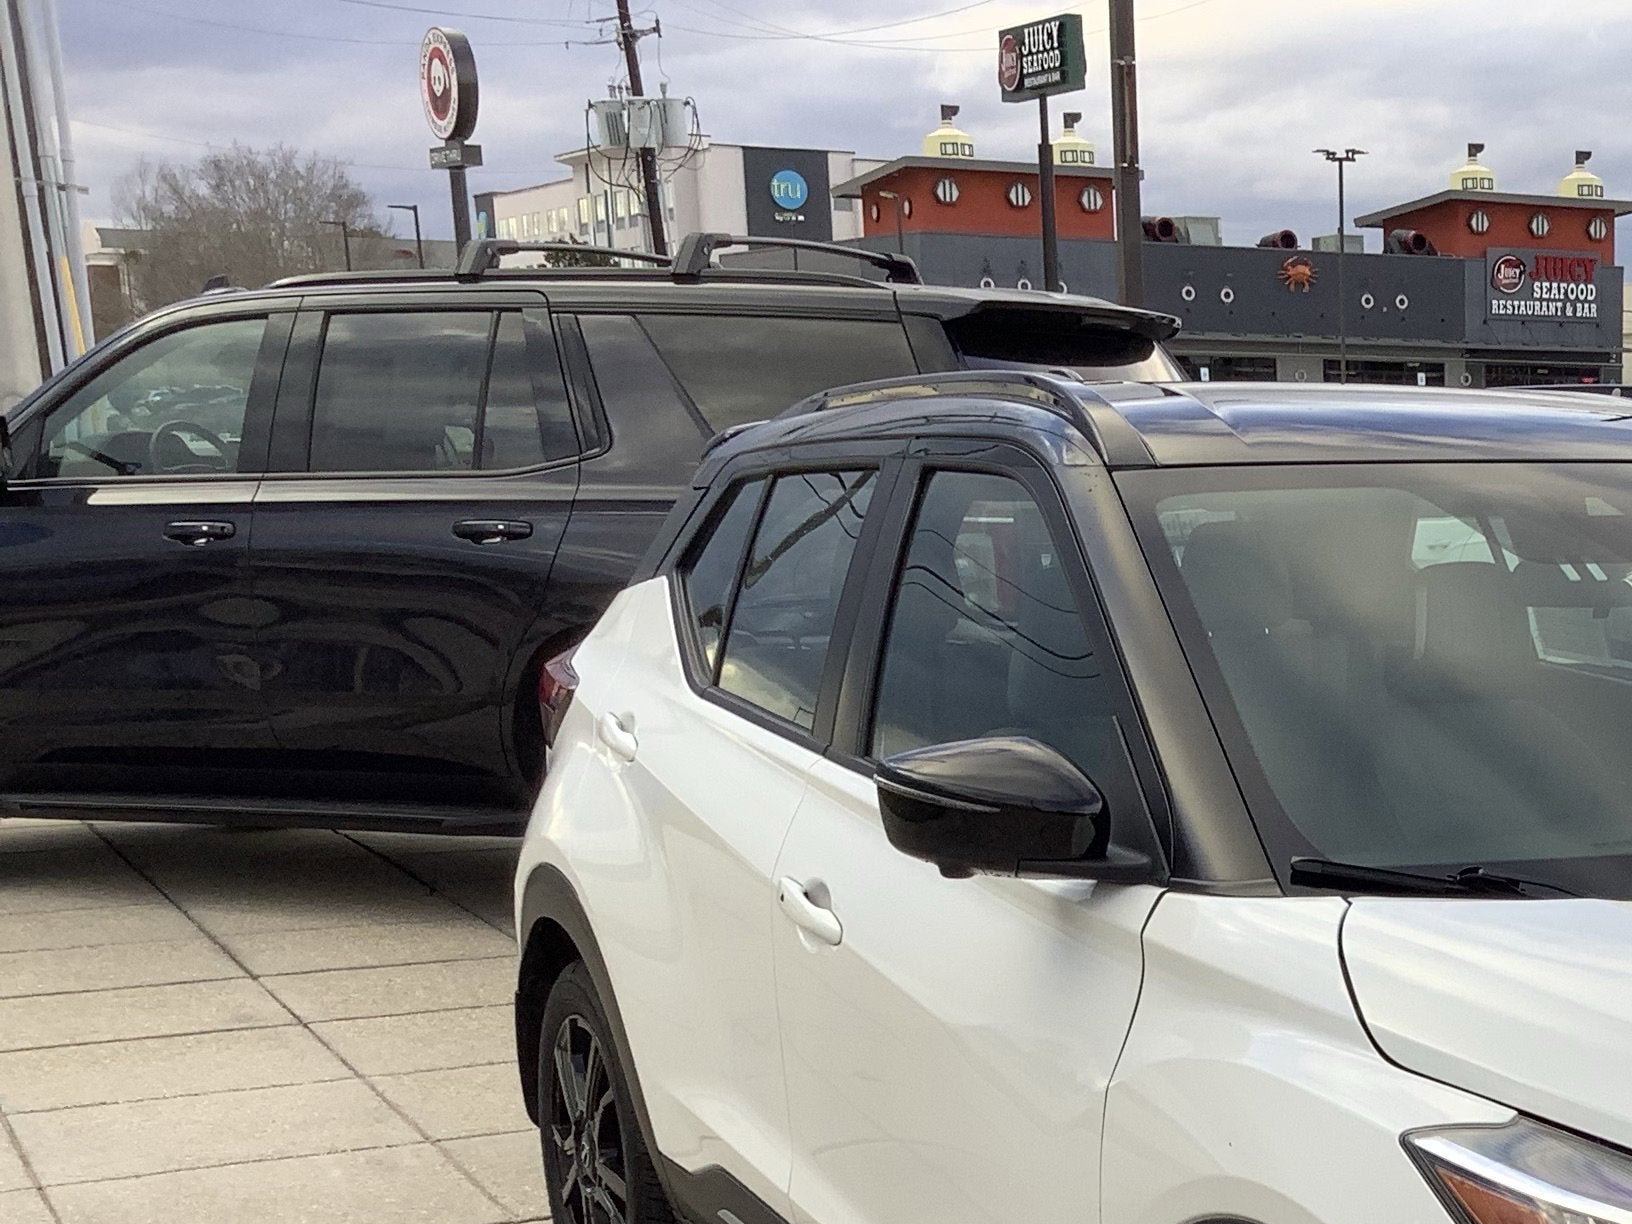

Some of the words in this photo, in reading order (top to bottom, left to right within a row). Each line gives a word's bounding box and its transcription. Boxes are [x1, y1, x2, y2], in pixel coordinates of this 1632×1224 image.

[1021, 20, 1060, 55] JUICY
[1022, 49, 1060, 74] SEAFOOD
[771, 178, 801, 199] tru
[1528, 255, 1598, 282] JUICY
[1533, 282, 1597, 300] SEAFOOD
[1491, 299, 1563, 316] RESTAURANT
[1565, 302, 1574, 317] &
[1576, 303, 1598, 317] BAR
